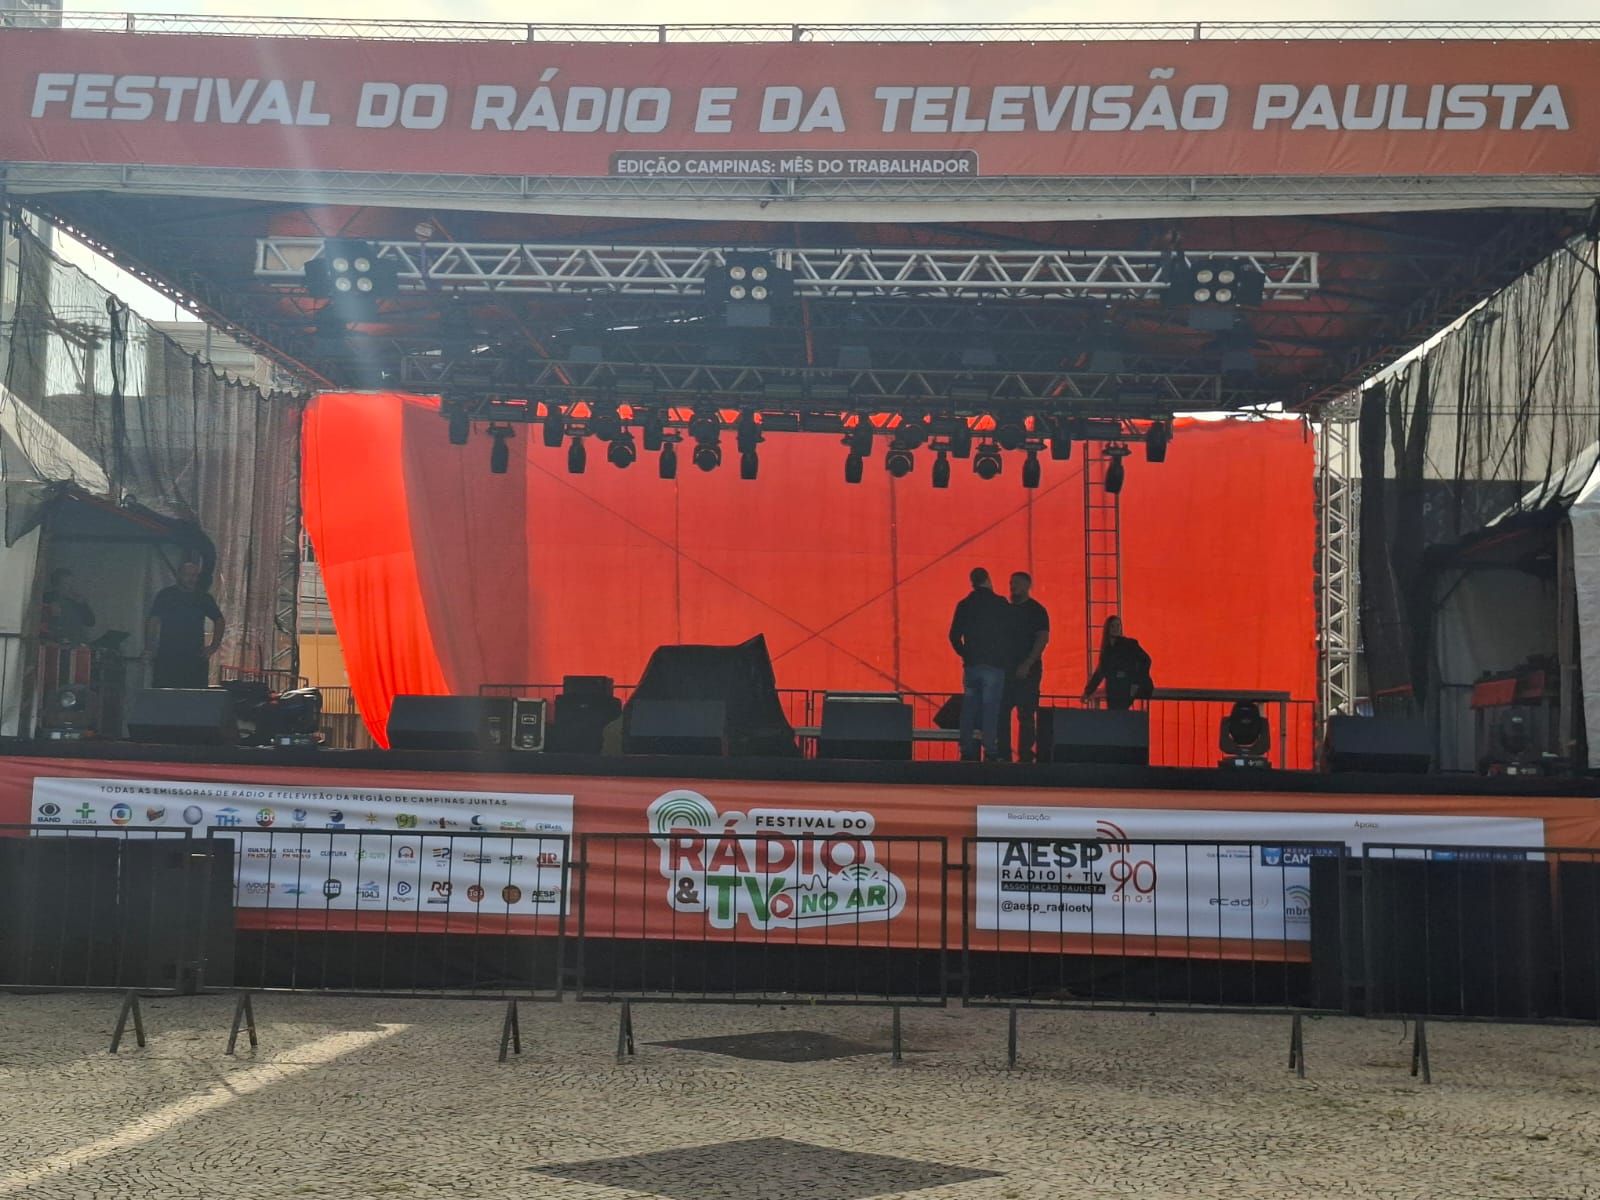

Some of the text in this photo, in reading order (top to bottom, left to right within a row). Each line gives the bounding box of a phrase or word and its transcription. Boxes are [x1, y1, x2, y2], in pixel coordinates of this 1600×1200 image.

[31, 67, 1570, 134] FESTIVAL DO RÁDIO E DA TELEVISÃO PAULISTA
[617, 155, 970, 176] EDIÇÃO CAMPINAS: MÊS DO TRABALHADOR
[101, 786, 135, 794] TODAS
[154, 787, 212, 796] EMISSORAS
[232, 789, 264, 798] RÁDIO
[277, 791, 333, 800] TELEVISÃO
[353, 793, 391, 802] REGIÃO
[411, 796, 464, 804] CAMPINAS
[468, 798, 507, 806] JUNTAS
[755, 816, 867, 829] FESTIVAL DO
[668, 819, 866, 874] RÁDIO
[1002, 839, 1103, 868] AESP
[1002, 867, 1056, 880] RÁDIO
[1083, 871, 1103, 882] TV
[1110, 859, 1157, 894] 90
[676, 875, 786, 921] & TV
[801, 885, 886, 913] NO AR
[1001, 900, 1093, 914] @aesp_radioetv
[1111, 894, 1152, 903] anos
